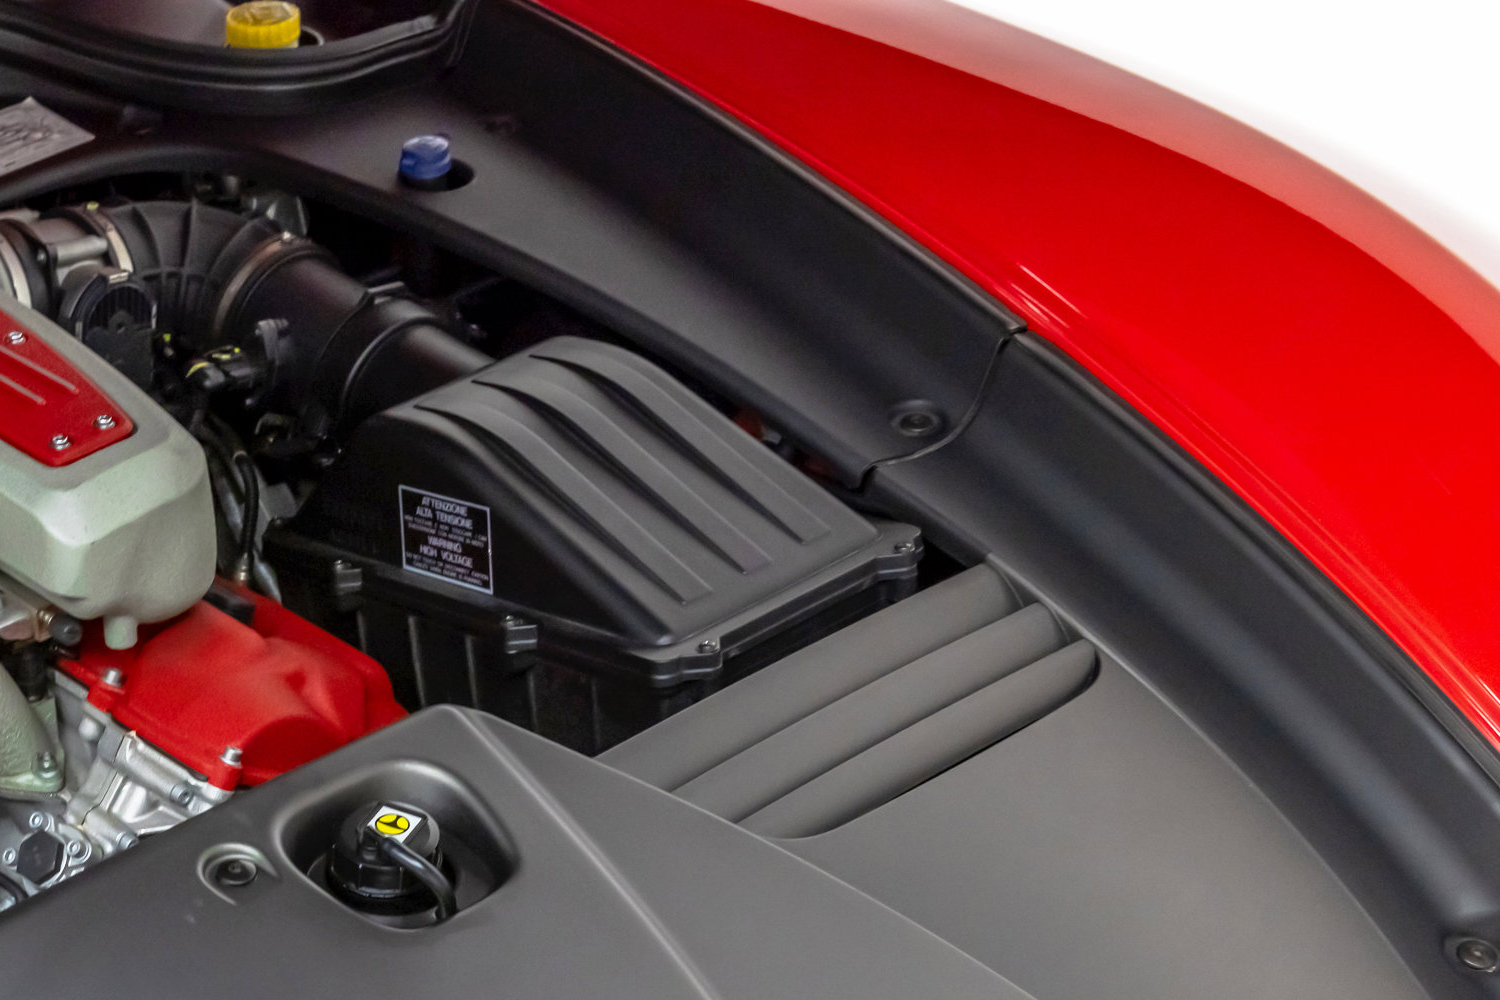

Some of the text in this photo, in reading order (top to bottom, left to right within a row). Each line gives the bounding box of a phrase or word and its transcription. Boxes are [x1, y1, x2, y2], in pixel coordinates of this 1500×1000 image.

[421, 496, 468, 517] ATTENZIONE
[416, 506, 433, 519] ALTA
[435, 511, 473, 530] TENSIONE
[428, 535, 462, 553] WARNING
[419, 544, 438, 558] HIGH
[440, 550, 473, 568] VOLTAGE
